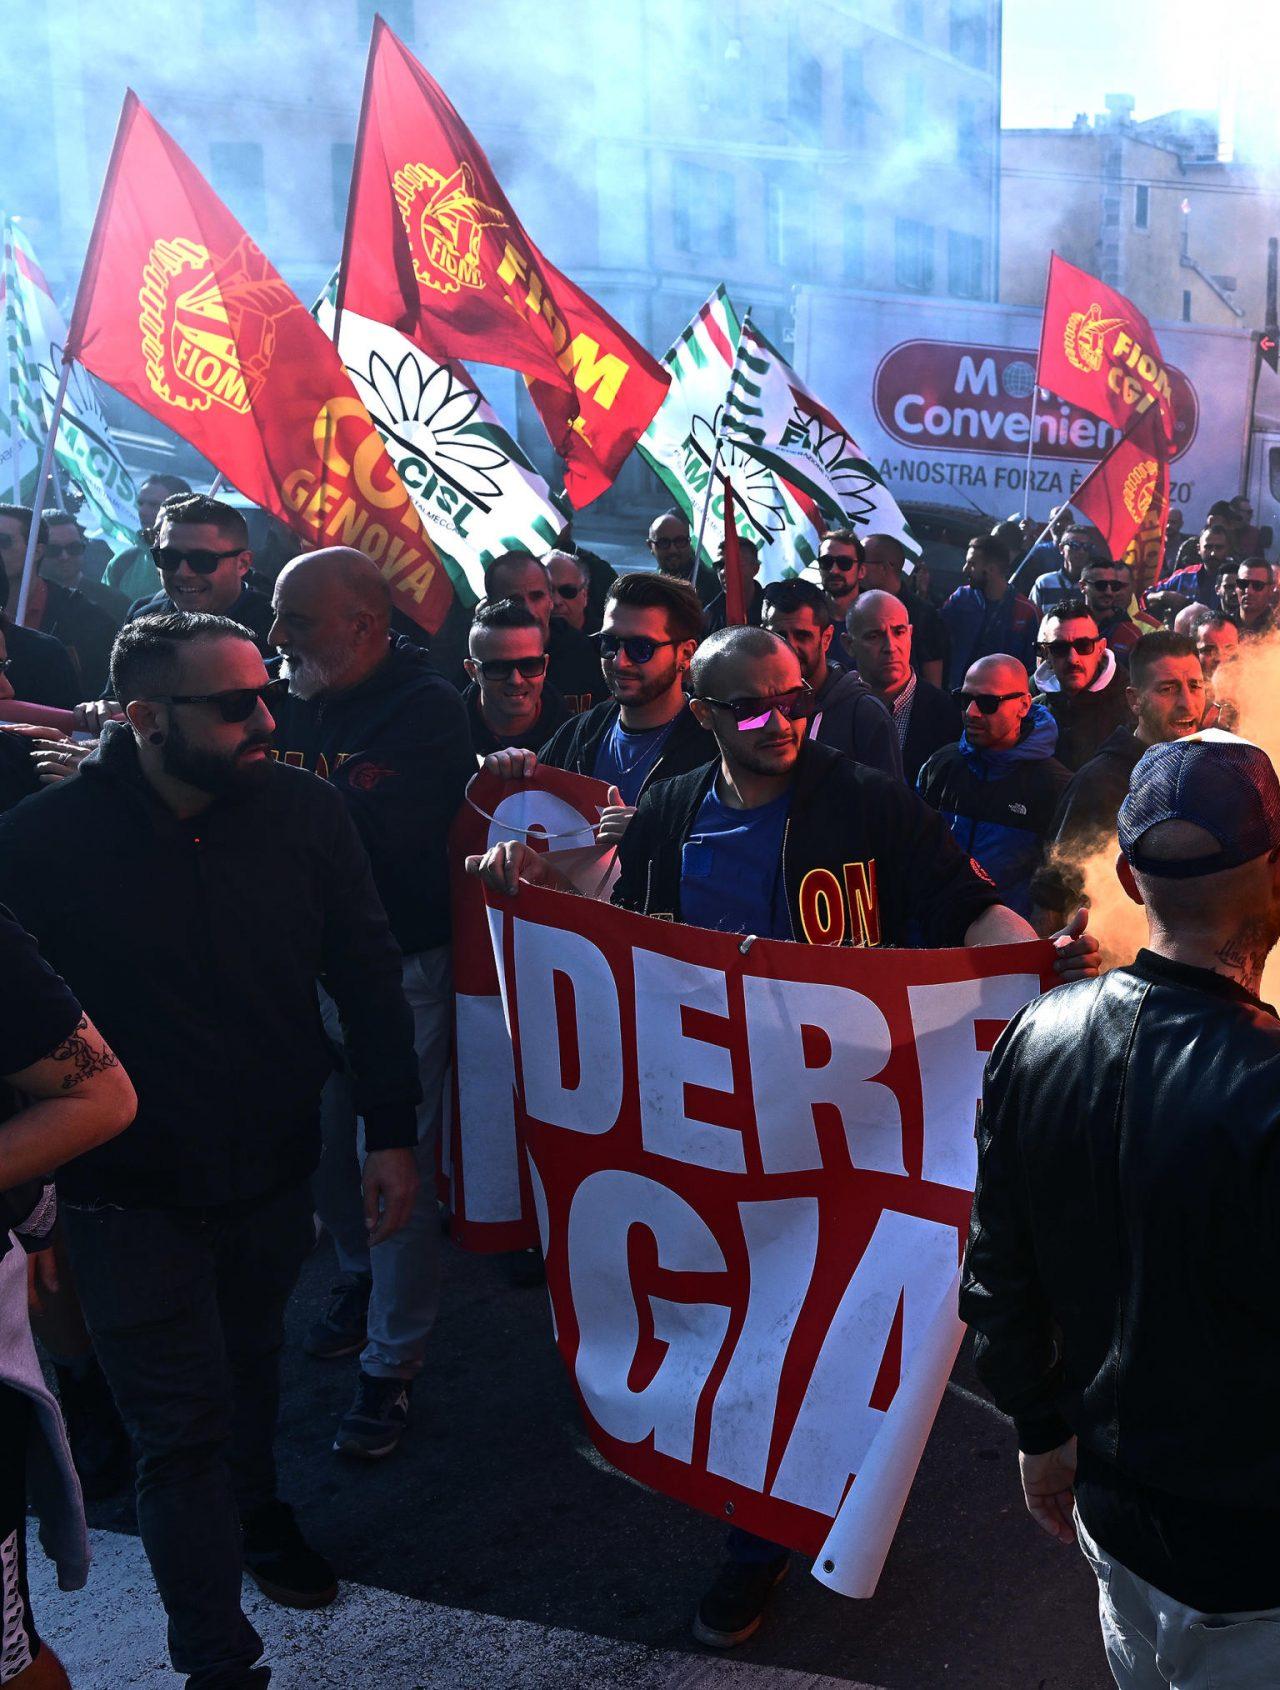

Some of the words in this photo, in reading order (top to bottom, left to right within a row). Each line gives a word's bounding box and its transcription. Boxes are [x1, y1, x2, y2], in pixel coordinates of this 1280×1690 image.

[175, 339, 249, 406] FIOM
[894, 393, 1122, 449] Convenien
[900, 459, 987, 487] NOSTRA
[994, 466, 1063, 493] FORZA
[281, 469, 436, 604] GENOVA
[550, 1167, 960, 1518] GIA
